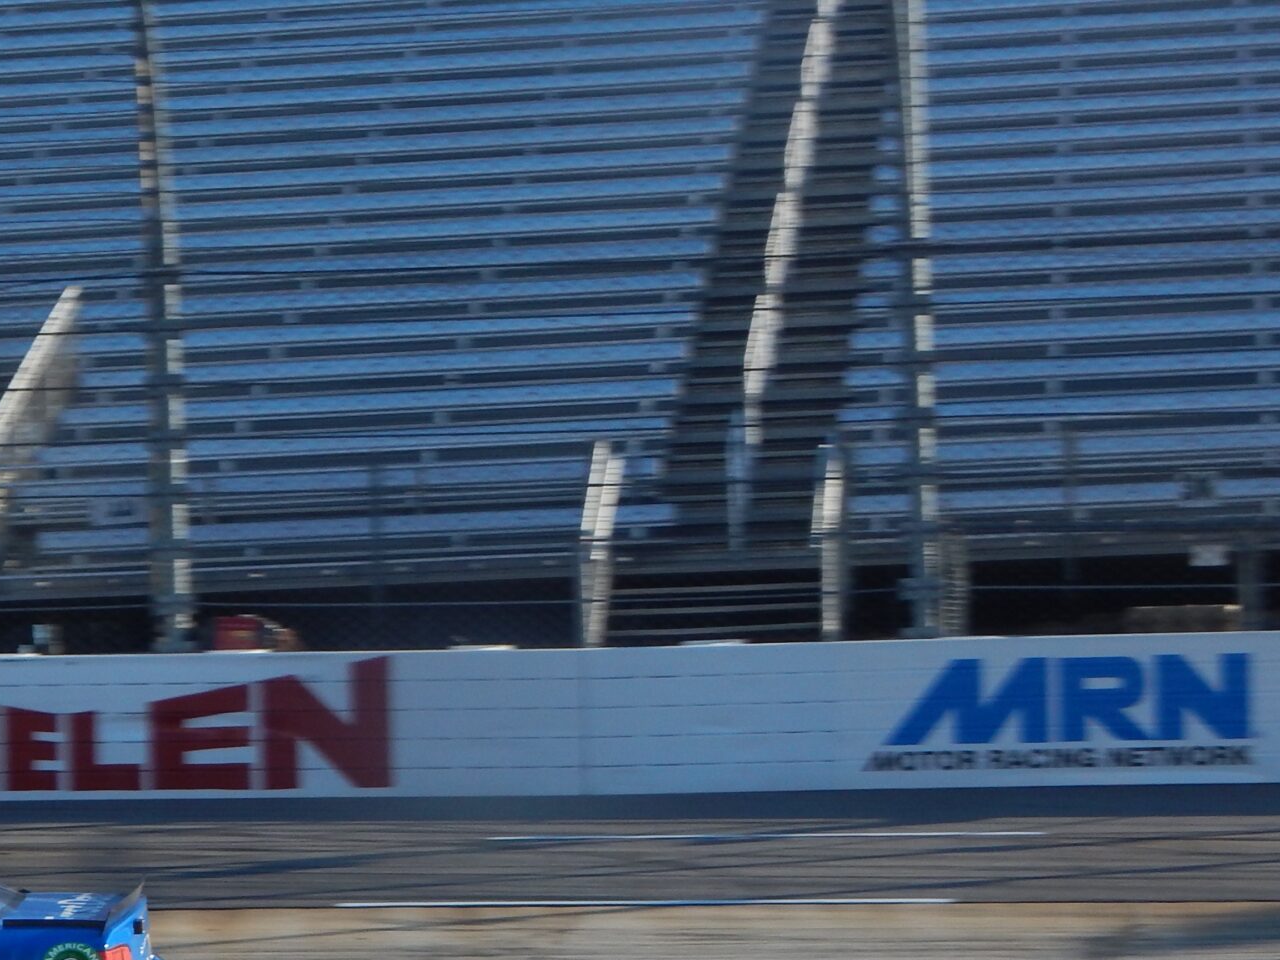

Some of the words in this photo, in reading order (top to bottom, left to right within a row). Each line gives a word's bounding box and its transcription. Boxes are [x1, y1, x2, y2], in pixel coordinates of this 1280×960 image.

[880, 653, 1253, 746] MRN
[863, 750, 978, 772] MOTOR
[988, 748, 1097, 770] RACING
[1104, 746, 1256, 768] NETWORK
